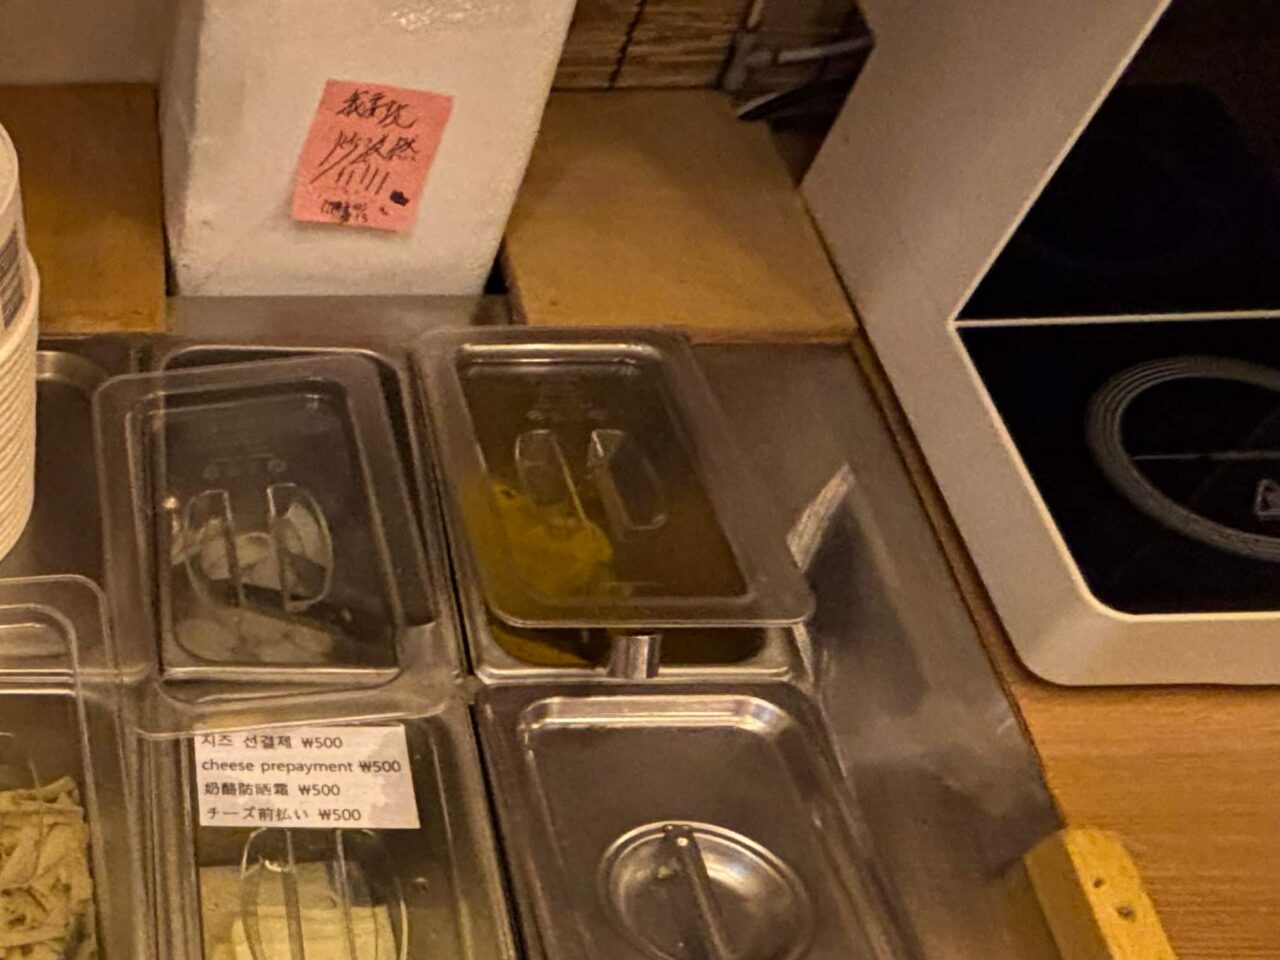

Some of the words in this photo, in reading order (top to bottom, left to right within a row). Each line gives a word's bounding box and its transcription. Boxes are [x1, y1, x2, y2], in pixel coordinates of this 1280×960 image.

[201, 758, 255, 773] cheese
[260, 760, 354, 776] prepayment
[206, 807, 310, 823] チーズ前払い
